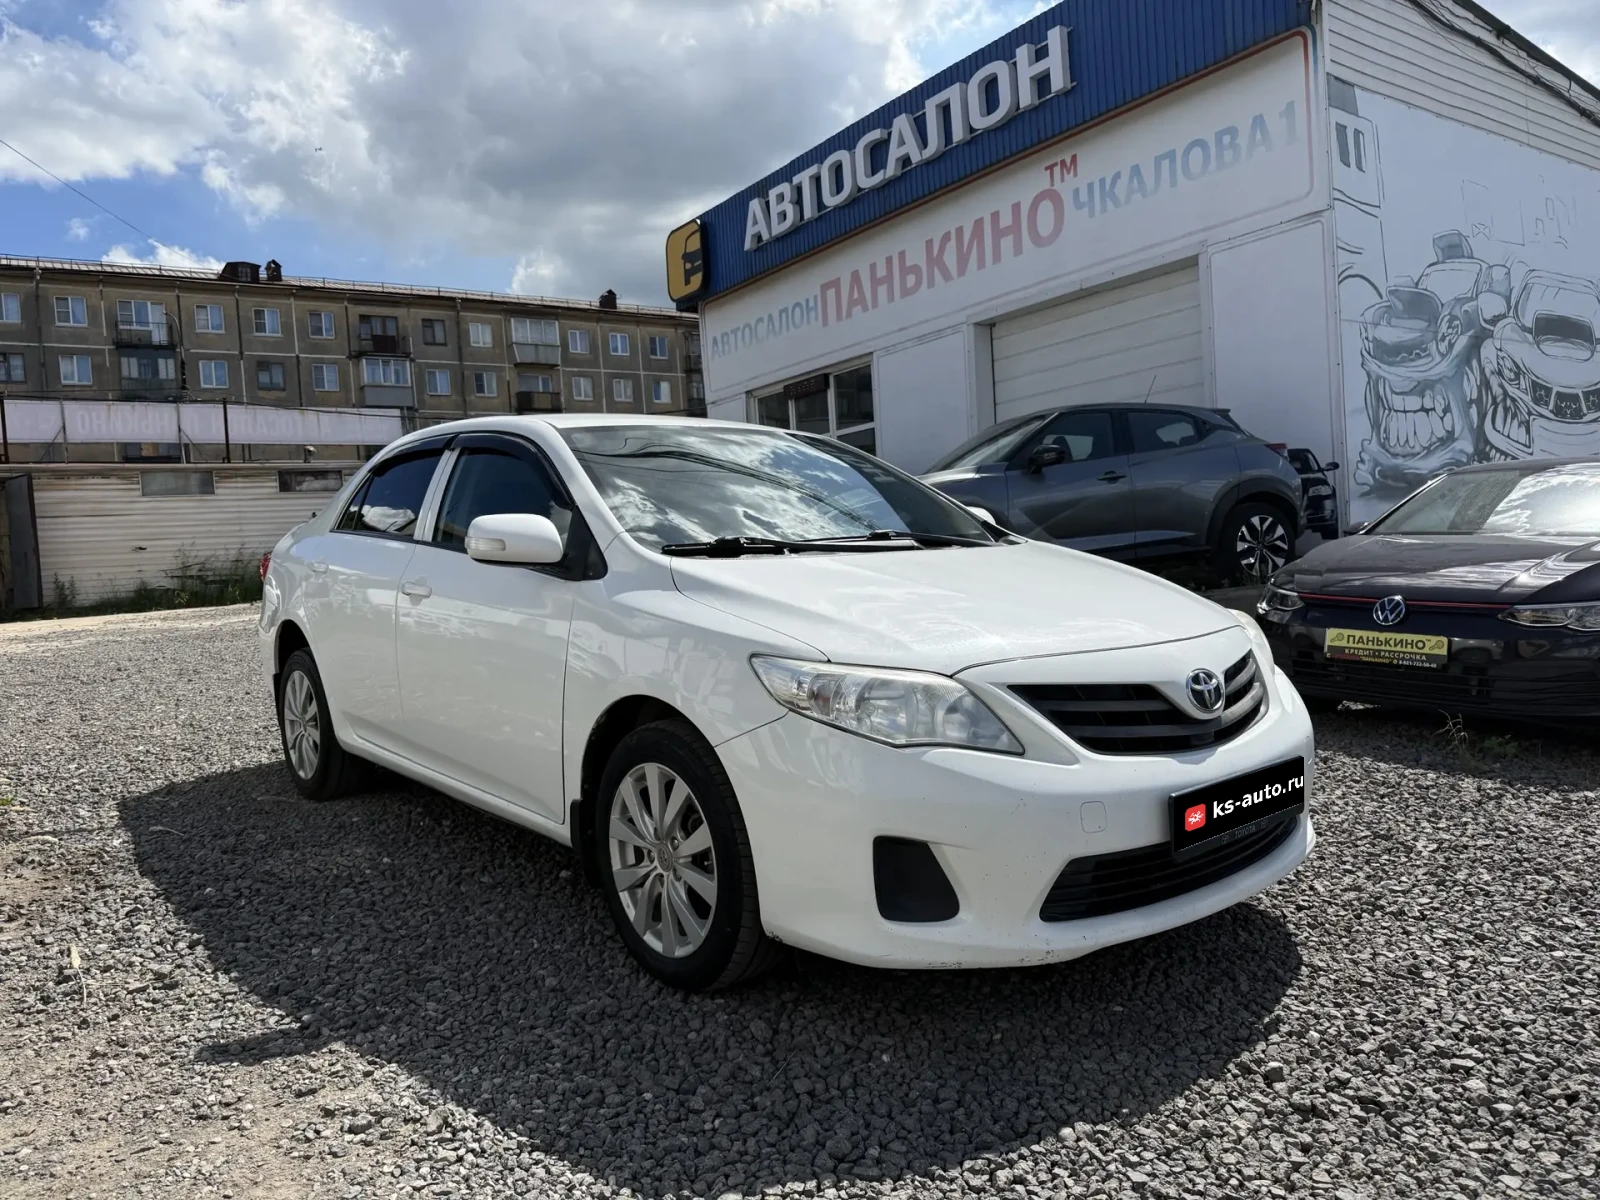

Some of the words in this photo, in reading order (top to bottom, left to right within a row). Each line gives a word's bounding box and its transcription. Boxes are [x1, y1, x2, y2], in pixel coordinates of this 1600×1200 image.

[743, 24, 1077, 252] АВТОСАЛОН
[709, 301, 819, 361] АВТОСАЛОН
[819, 188, 1066, 329] ПАНЬКИНО
[1071, 112, 1275, 219] ЧКАЛОВА
[1277, 99, 1301, 146] 1
[1346, 634, 1426, 650] ПАНЬКИНО
[1344, 648, 1374, 657] КРЕДИТ
[1380, 651, 1427, 661] РАССРОЧКА
[1234, 825, 1256, 840] TOYOTA
